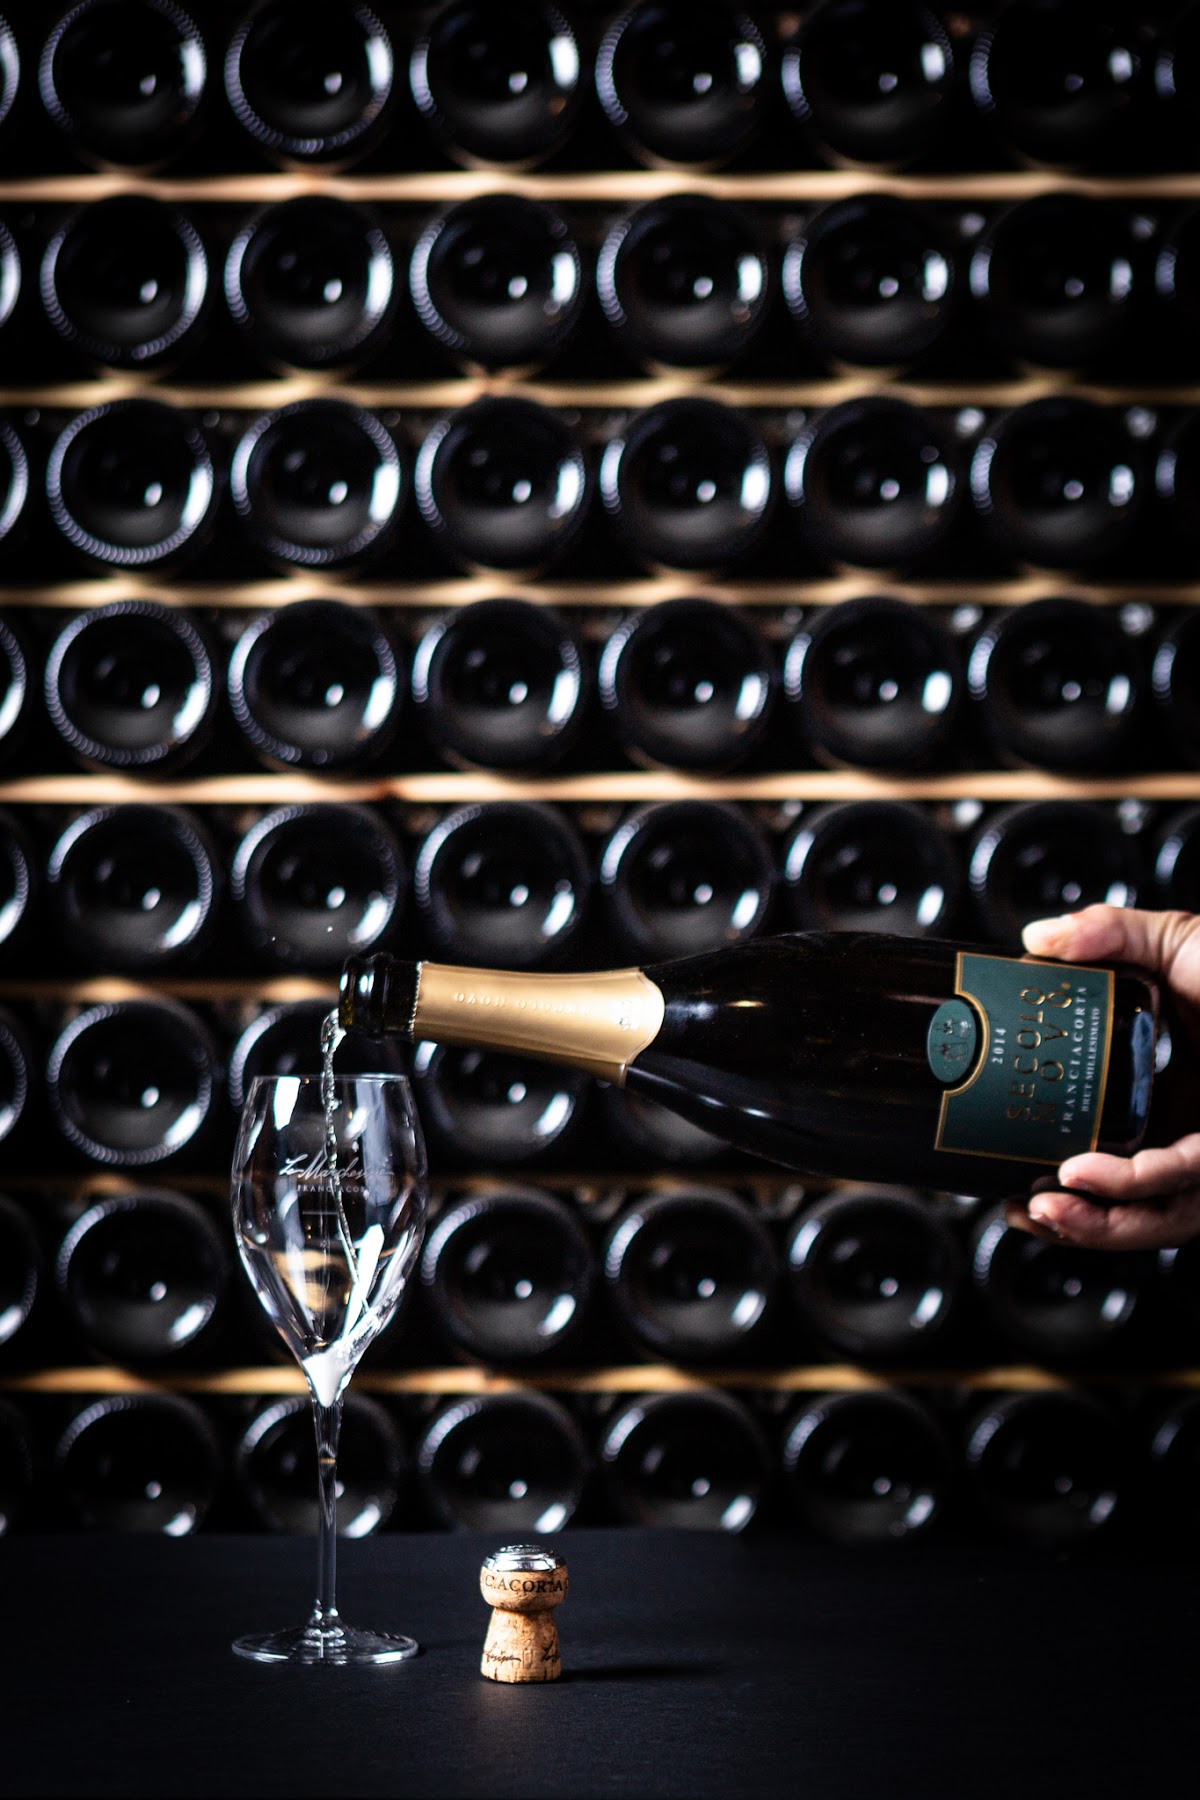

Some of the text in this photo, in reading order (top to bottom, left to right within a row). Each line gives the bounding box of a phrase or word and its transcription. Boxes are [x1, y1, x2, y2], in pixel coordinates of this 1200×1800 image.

[992, 1027, 1007, 1064] 2014
[1006, 987, 1046, 1121] SECOLO
[1061, 986, 1087, 1133] FRANCIACORTA
[1081, 1008, 1101, 1112] BRUT MILLESIMATO
